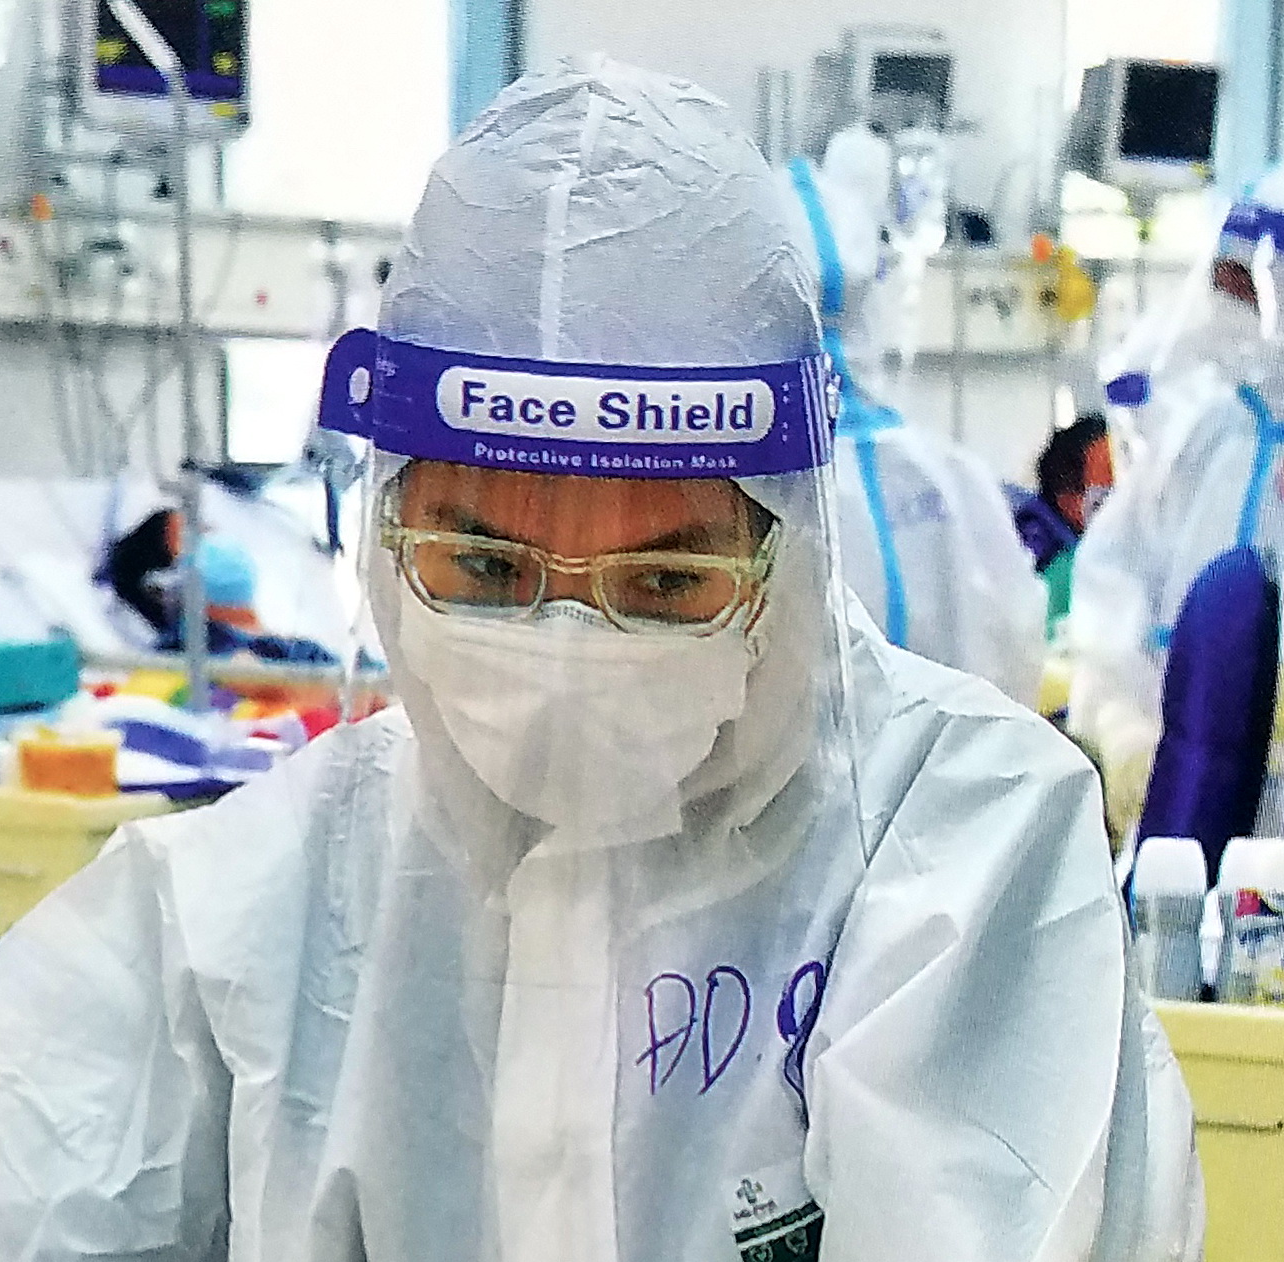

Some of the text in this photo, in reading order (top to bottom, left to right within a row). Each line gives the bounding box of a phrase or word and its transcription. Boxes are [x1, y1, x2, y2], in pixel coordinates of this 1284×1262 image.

[460, 380, 755, 432] Face Shield
[474, 441, 737, 470] Protective Isolation Mask
